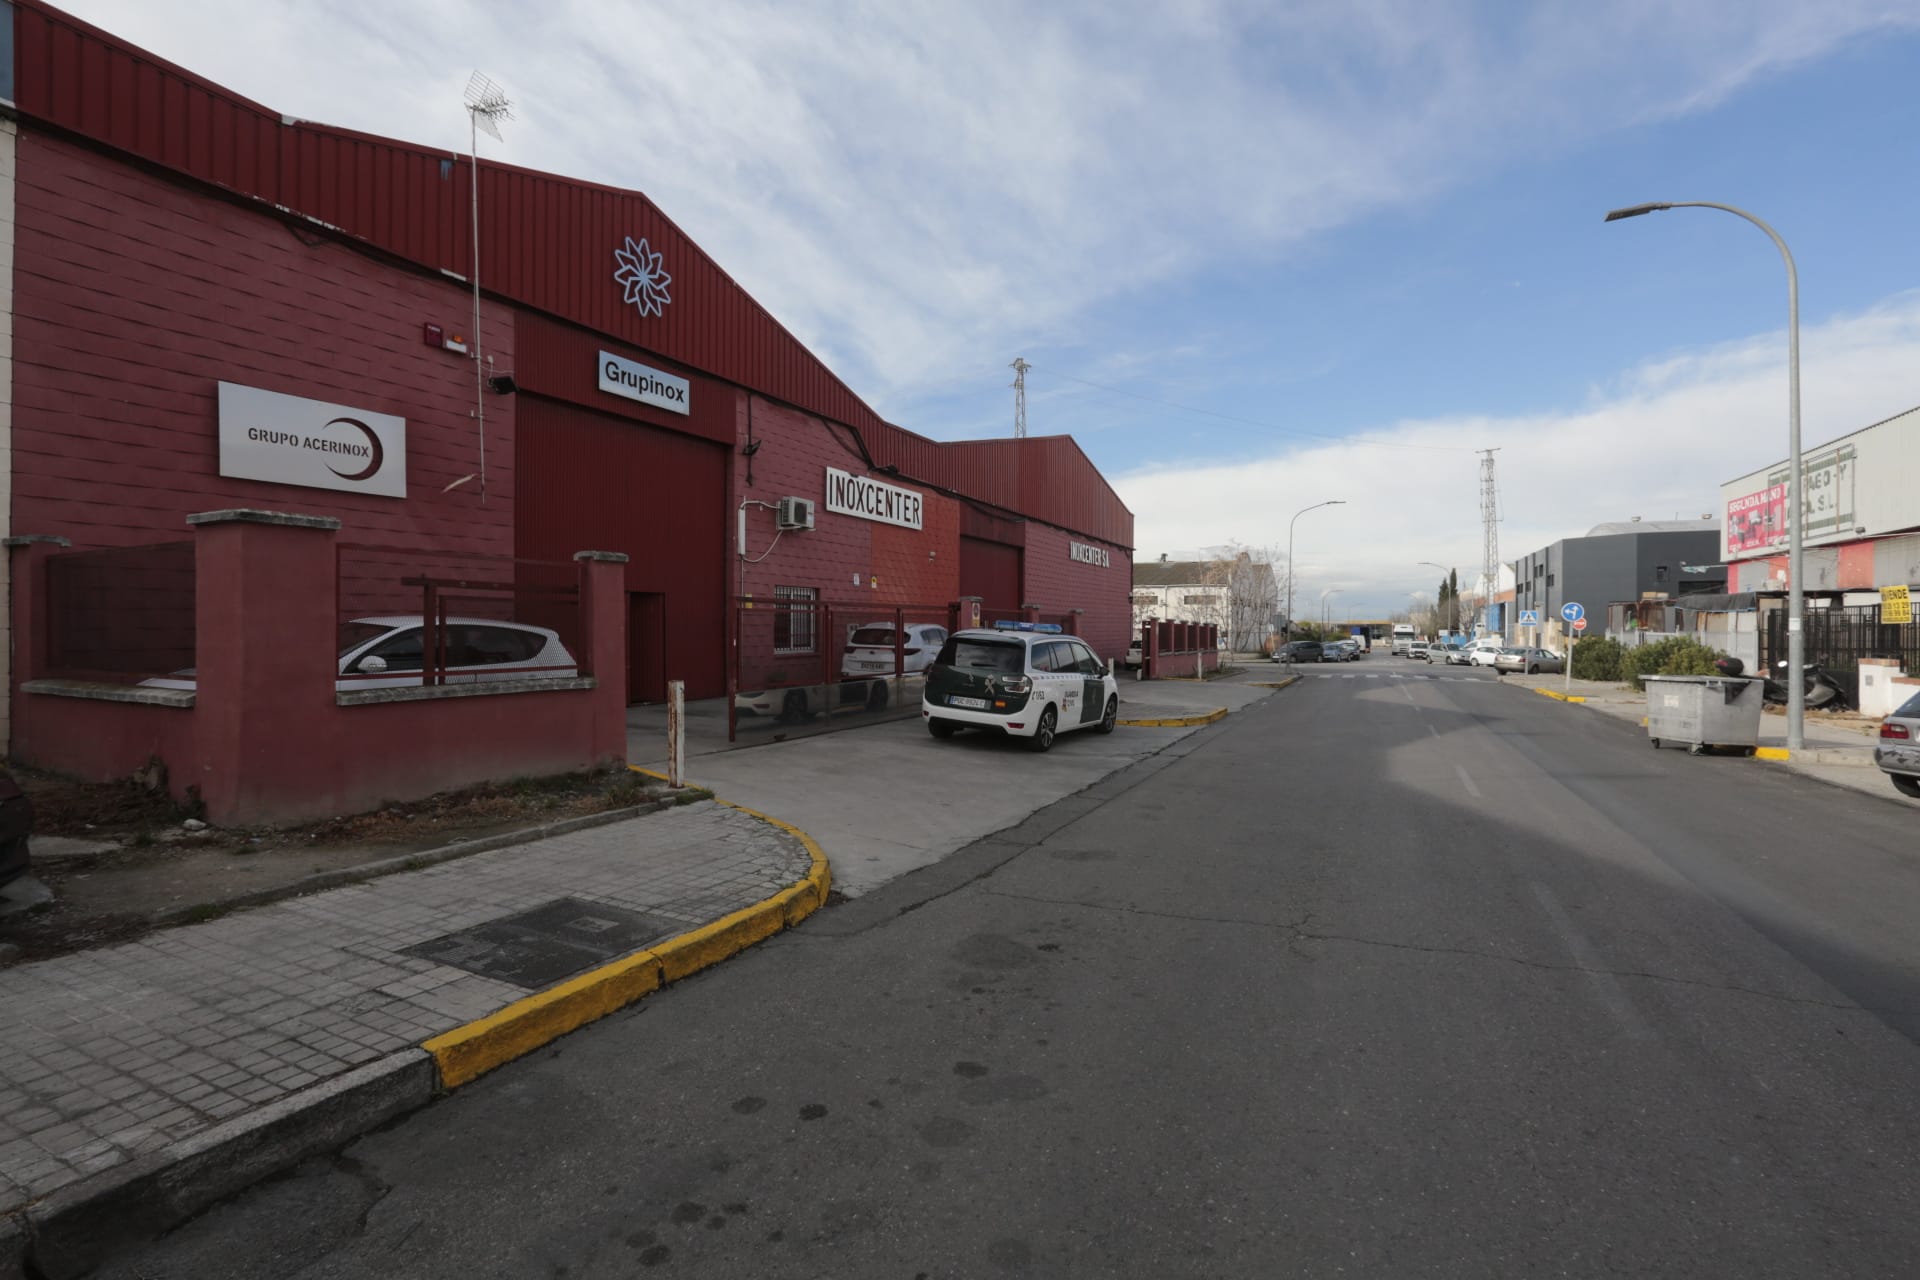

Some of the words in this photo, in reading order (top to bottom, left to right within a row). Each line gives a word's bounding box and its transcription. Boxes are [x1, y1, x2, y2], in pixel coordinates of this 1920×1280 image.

[605, 361, 684, 403] Grupinox
[248, 428, 299, 447] GRUPO
[303, 437, 370, 458] ACERINOX
[829, 473, 920, 525] INOXCENTER
